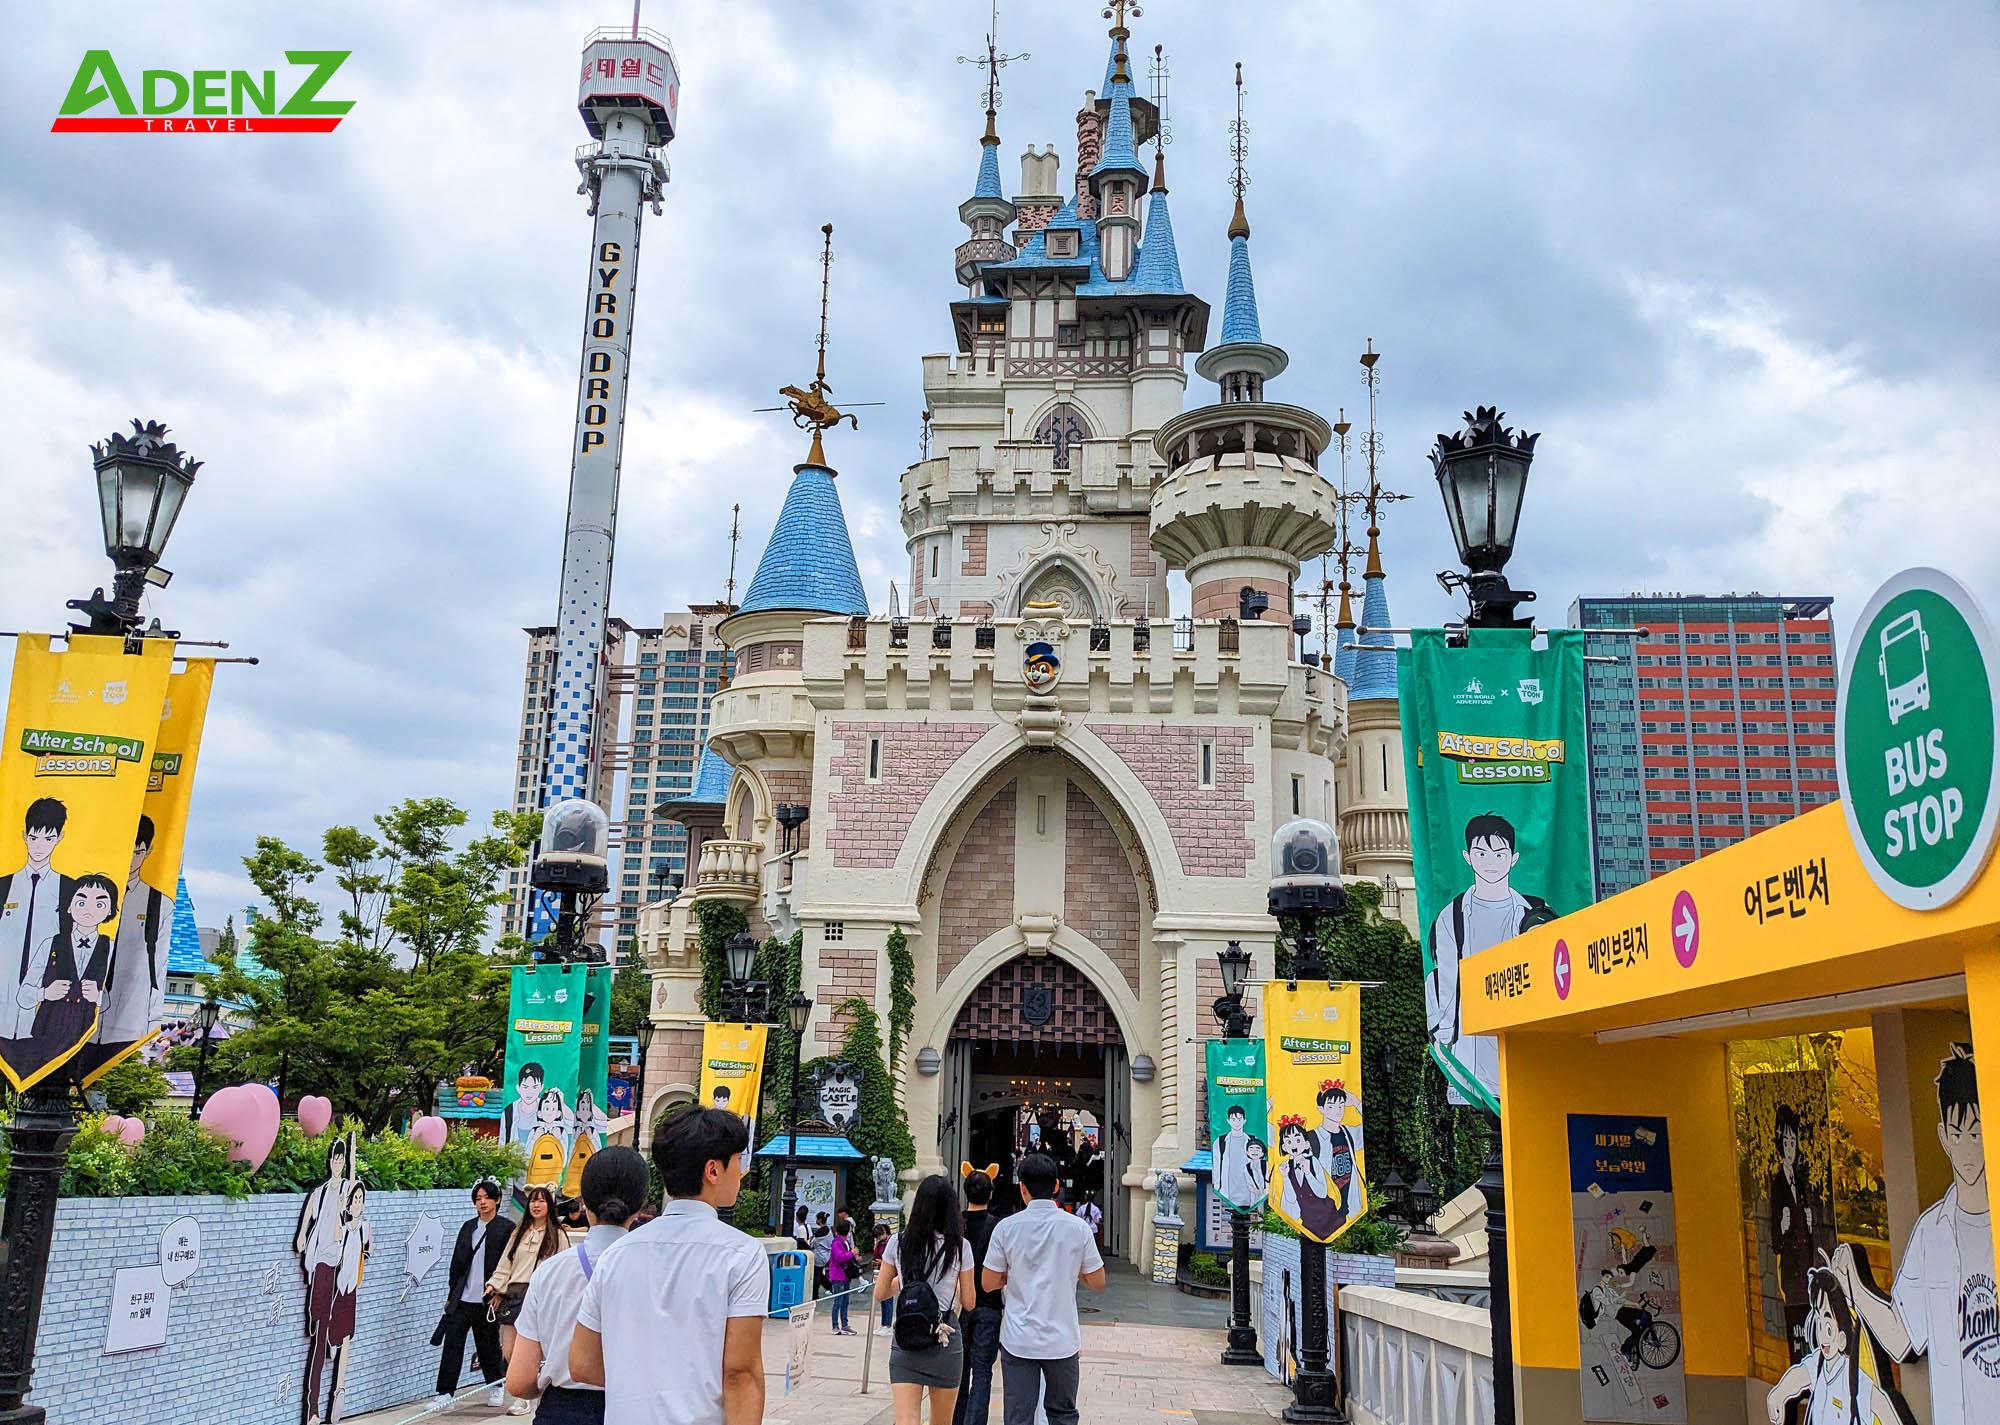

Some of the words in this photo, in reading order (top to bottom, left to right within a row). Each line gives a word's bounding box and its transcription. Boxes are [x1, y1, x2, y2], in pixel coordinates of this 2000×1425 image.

[593, 242, 622, 339] GYRO
[582, 352, 613, 455] DROP
[1521, 690, 1541, 698] TOON
[1523, 684, 1537, 692] WEB
[25, 732, 70, 749] After
[1441, 734, 1494, 756] After
[37, 755, 112, 771] Lessons
[1885, 728, 1947, 797] BUS
[1461, 763, 1545, 779] Lessons
[1884, 787, 1963, 857] STOP
[1744, 857, 1830, 926] 어드벤처
[1587, 923, 1649, 975] 메인브릿지
[1485, 962, 1531, 1001] 매직아일랜드
[525, 1033, 563, 1042] Lessons
[1283, 1038, 1312, 1049] After
[1293, 1052, 1338, 1062] Lessons
[828, 1086, 852, 1094] MAGIC
[821, 1095, 857, 1103] CASTLE
[130, 1293, 142, 1305] 친구
